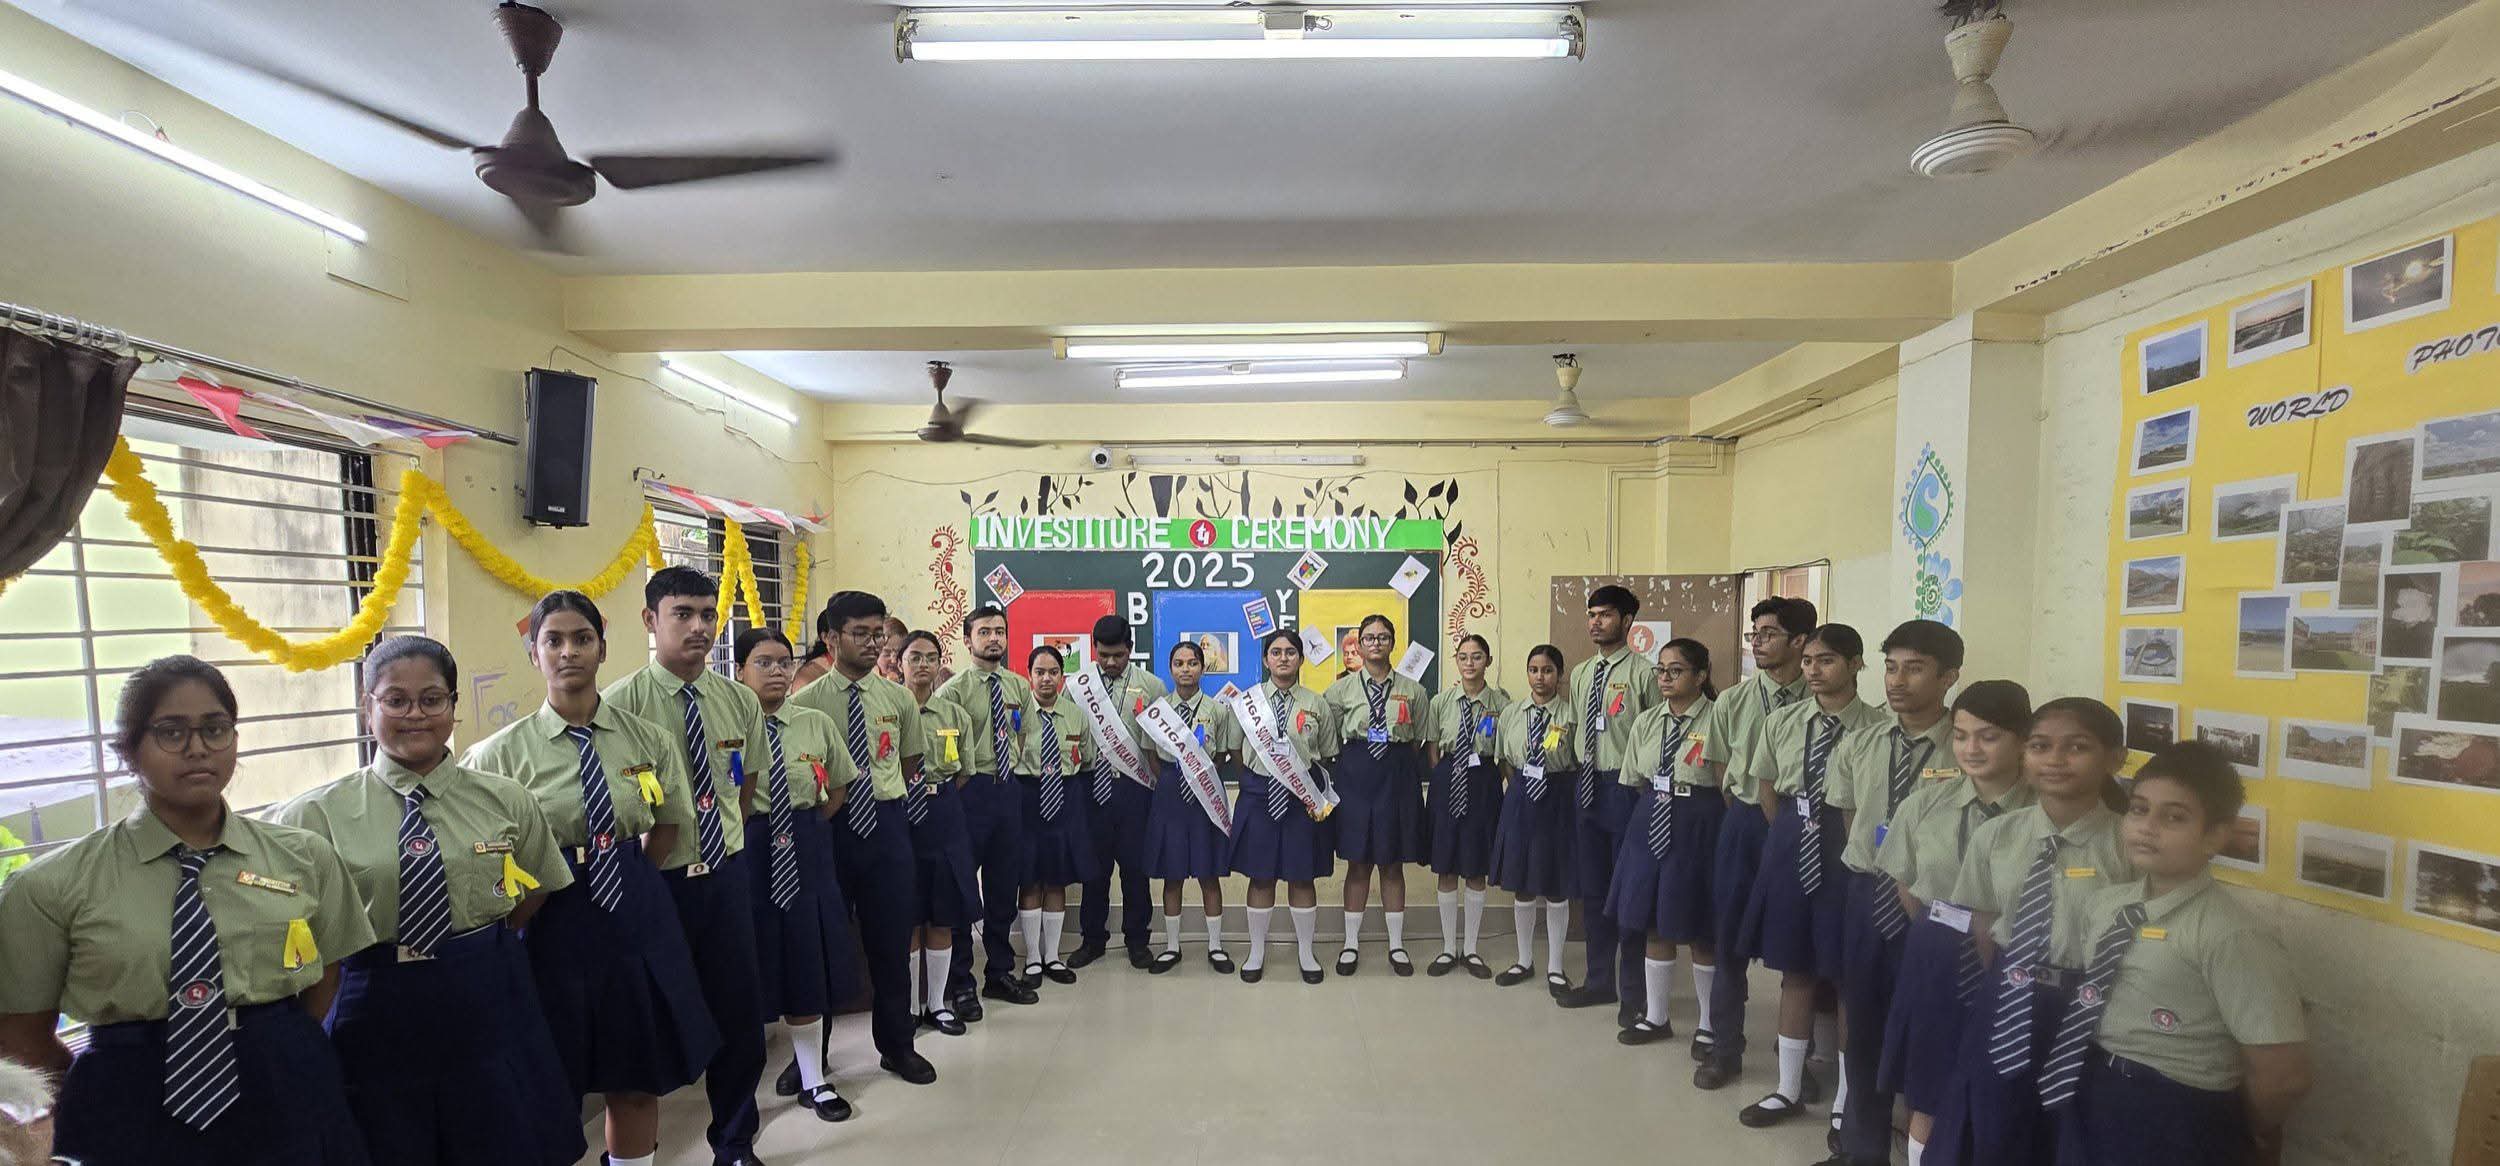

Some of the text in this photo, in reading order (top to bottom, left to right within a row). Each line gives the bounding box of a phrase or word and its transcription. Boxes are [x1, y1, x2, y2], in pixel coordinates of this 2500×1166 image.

[2247, 388, 2349, 428] WORLD
[975, 515, 1171, 549] INVESTITURE
[1231, 515, 1397, 550] CEREMONY
[1142, 552, 1255, 588] 2025
[1083, 686, 1105, 725] TIGA
[1157, 718, 1186, 753] TIGA
[1183, 751, 1202, 775] SOUTH
[1242, 692, 1262, 727] TIGA
[1287, 771, 1307, 797] HEAD
